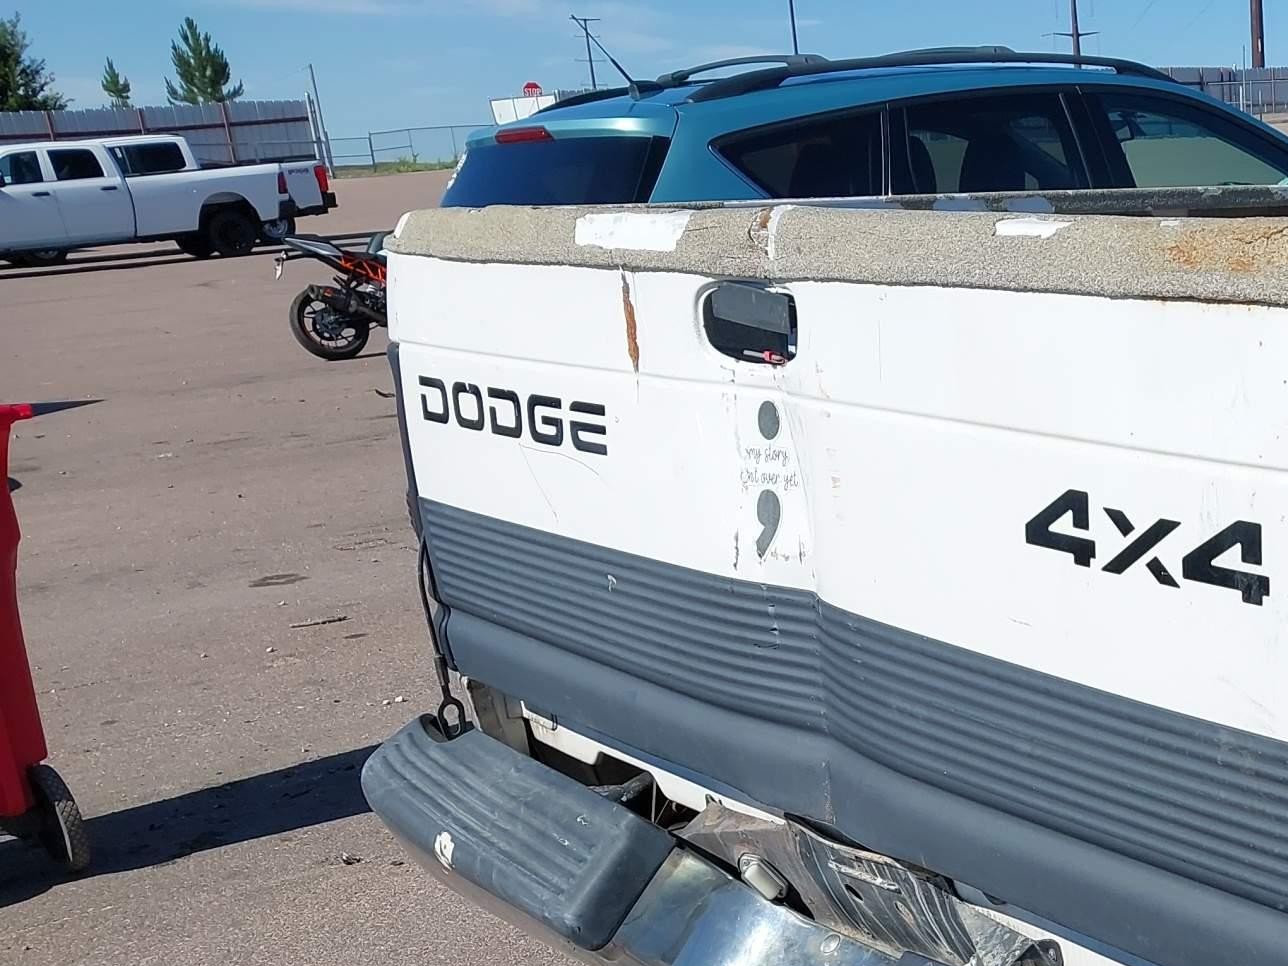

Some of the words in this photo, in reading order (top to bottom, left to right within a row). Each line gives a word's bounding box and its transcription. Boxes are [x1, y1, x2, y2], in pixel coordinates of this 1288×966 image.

[524, 87, 542, 97] STOP
[418, 375, 608, 456] DODGE
[764, 442, 788, 467] story
[760, 471, 780, 485] over
[783, 470, 799, 491] yet
